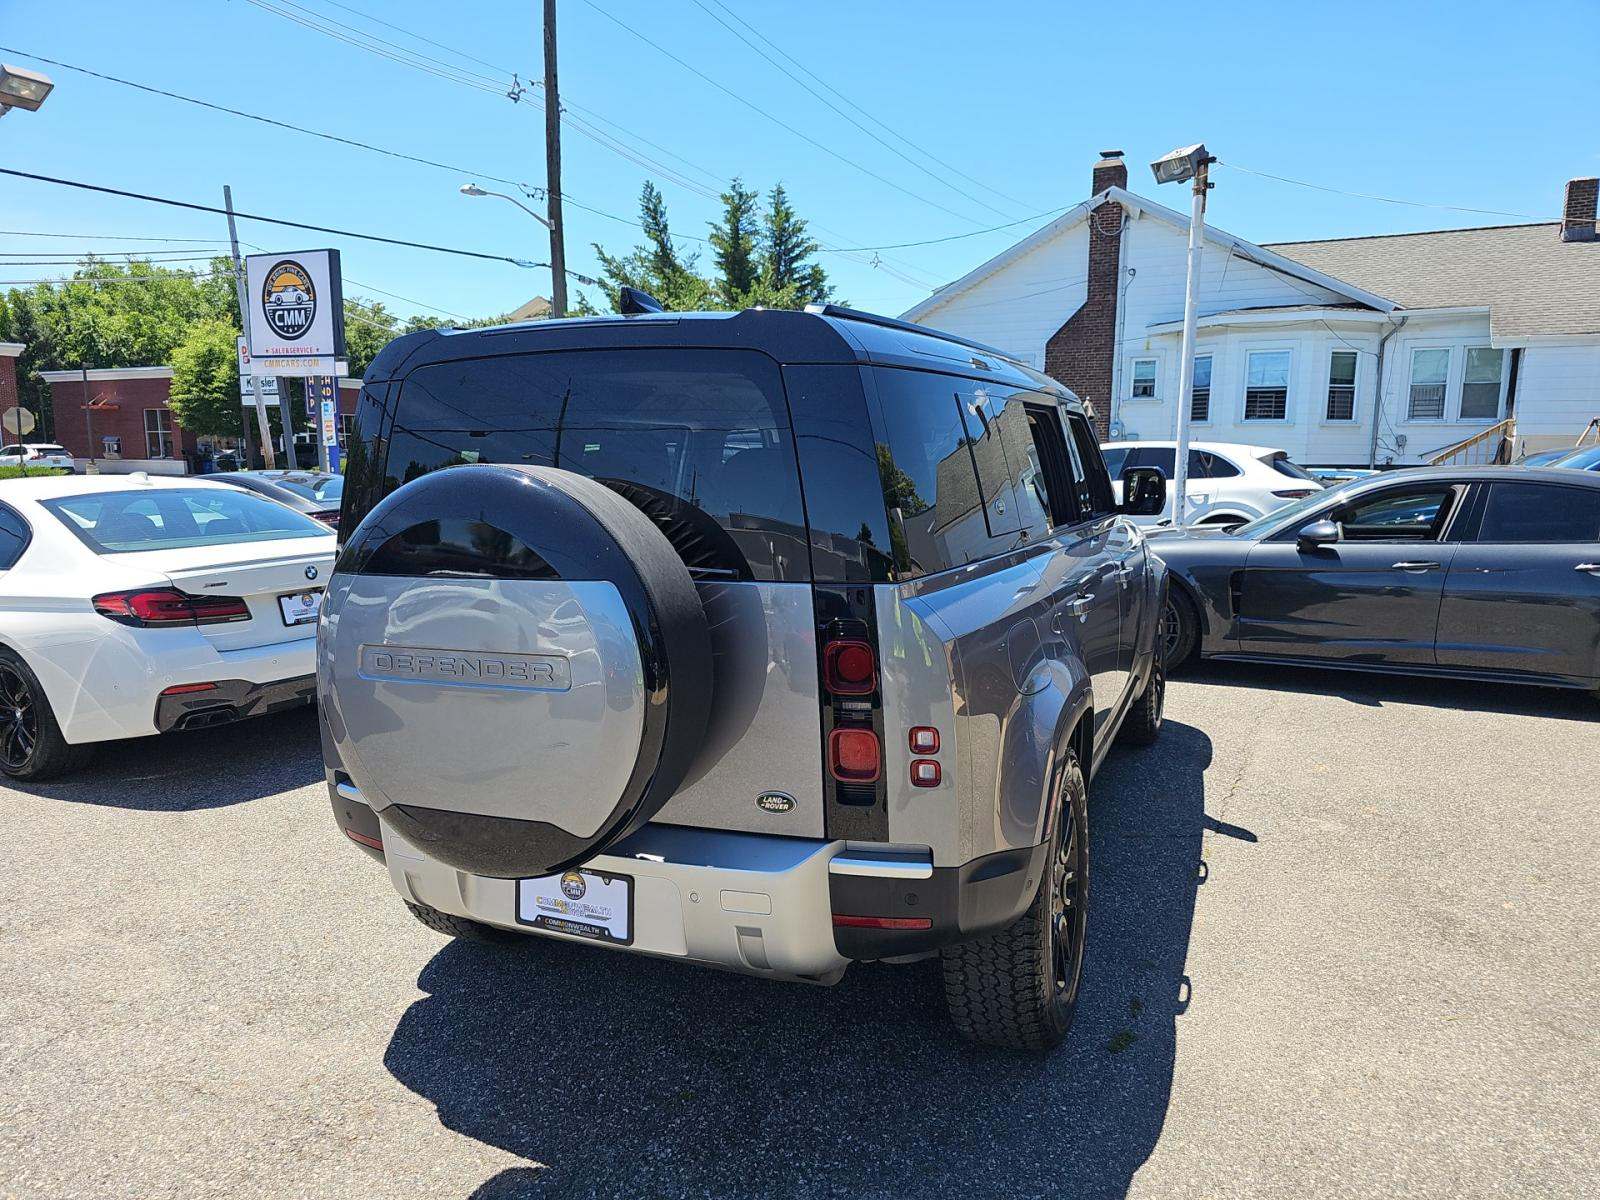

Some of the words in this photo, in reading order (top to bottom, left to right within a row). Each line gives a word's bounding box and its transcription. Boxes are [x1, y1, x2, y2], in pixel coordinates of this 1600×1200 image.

[275, 309, 306, 326] CMM
[264, 358, 320, 368] CMMCARS.COM
[246, 377, 275, 388] Ksler
[373, 652, 554, 682] DEFENDER
[544, 917, 600, 934] COMMONWEALTH
